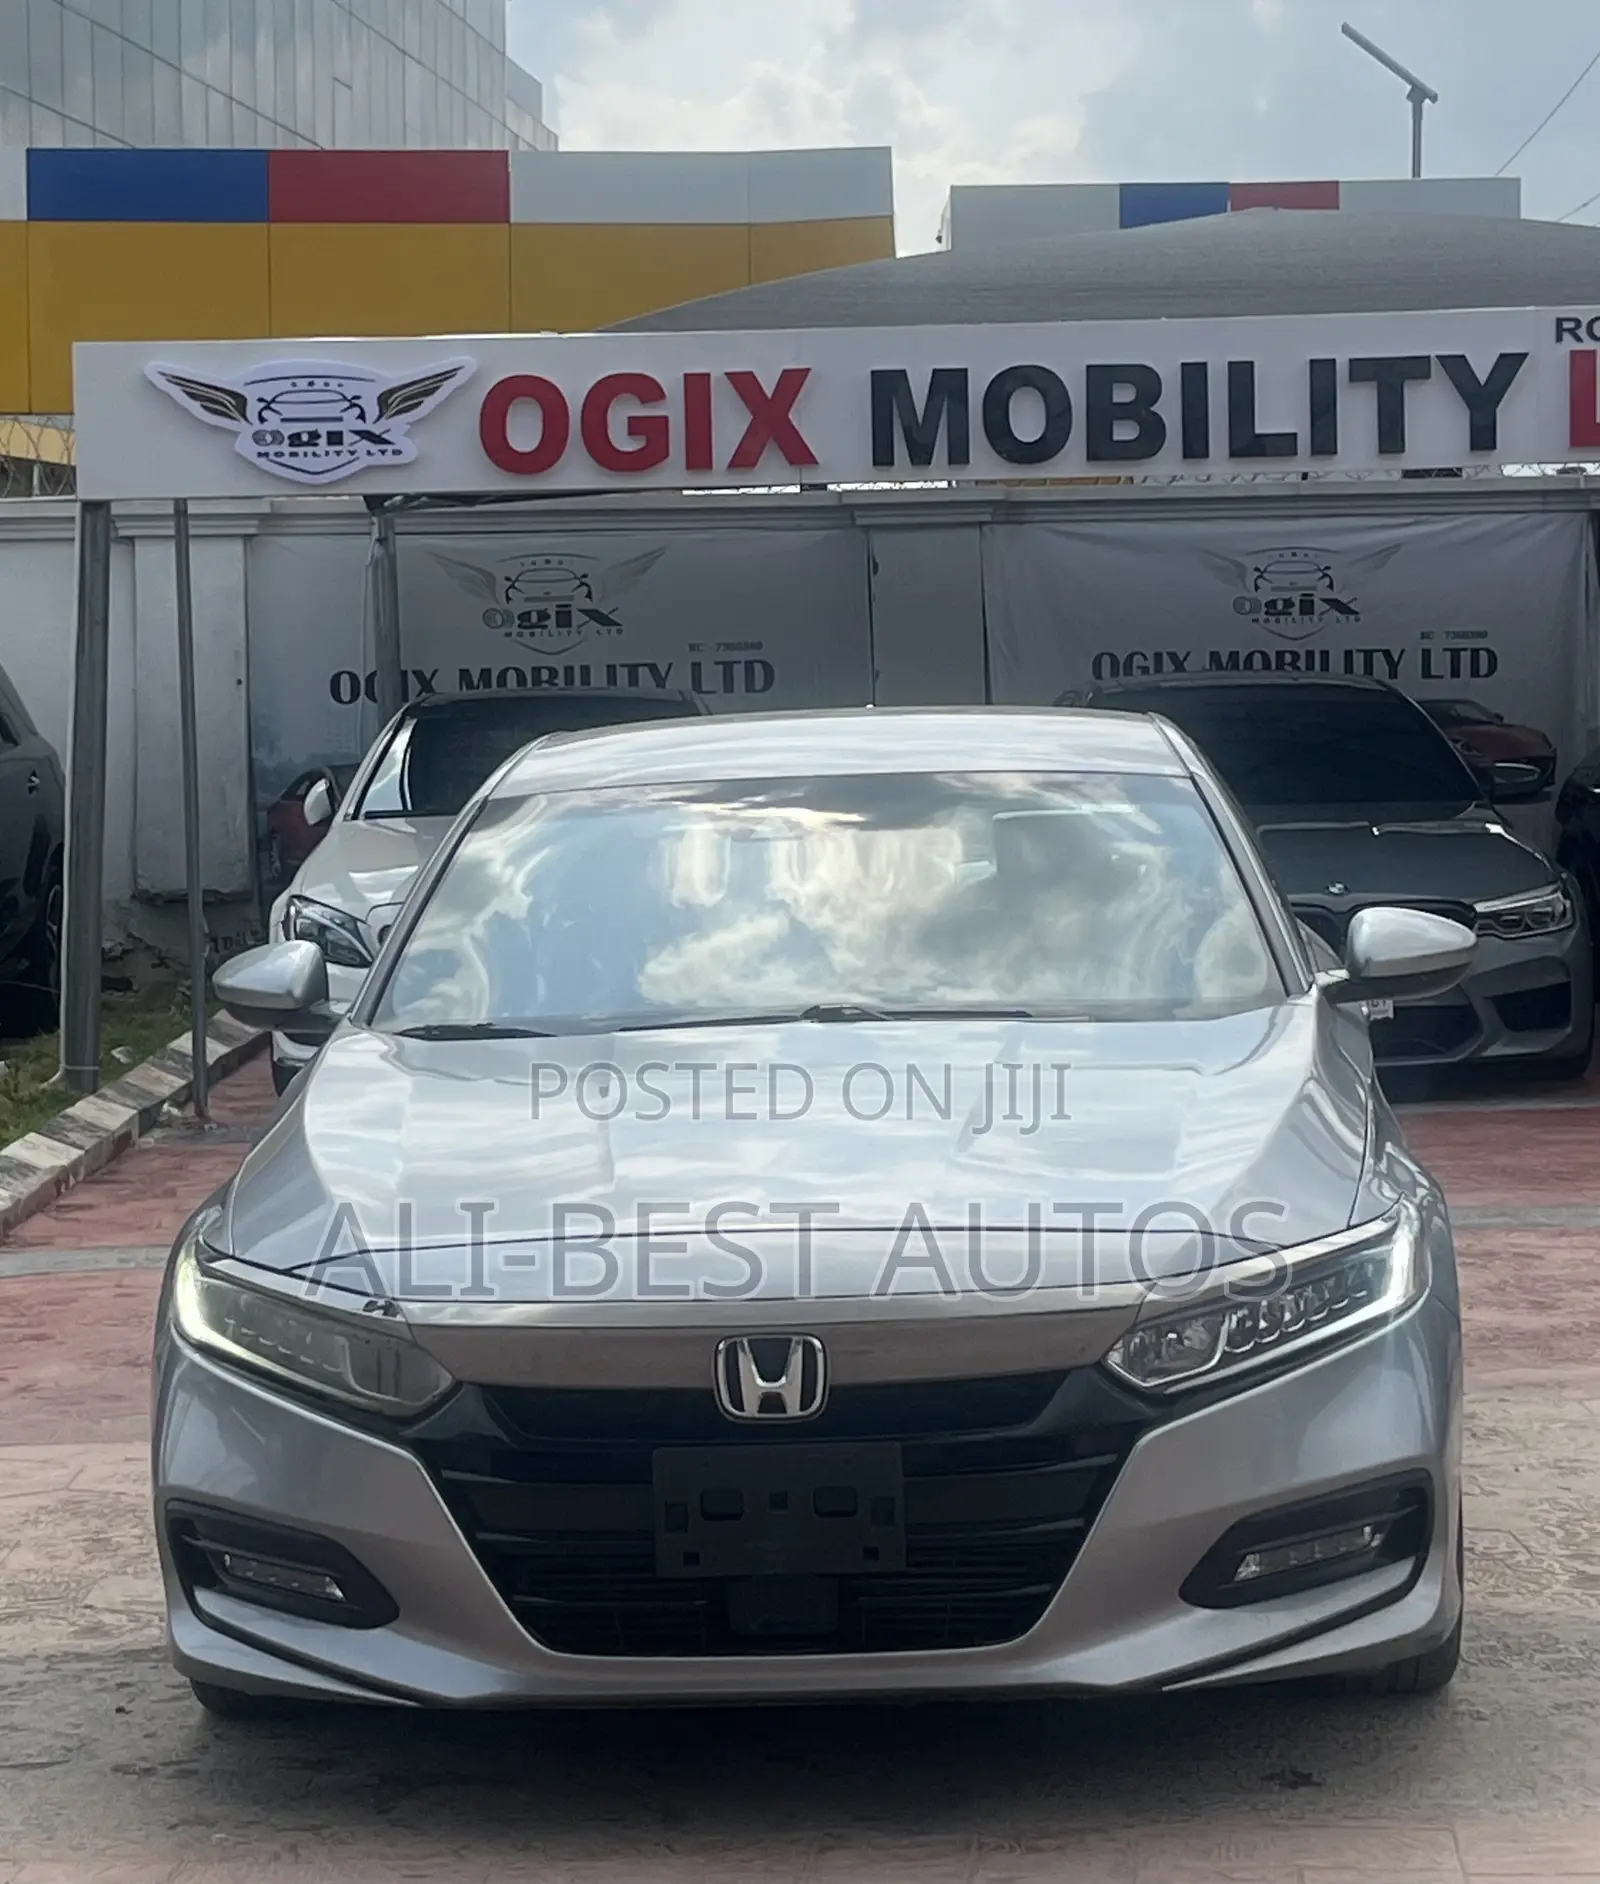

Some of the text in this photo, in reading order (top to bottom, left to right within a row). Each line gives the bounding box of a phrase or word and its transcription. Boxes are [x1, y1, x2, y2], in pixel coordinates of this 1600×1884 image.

[479, 367, 818, 475] OGIX
[870, 352, 1529, 467] MOBILITY
[256, 449, 403, 458] MOBILITY LTD
[690, 658, 775, 694] LTD
[1092, 650, 1191, 680] OGIX
[1421, 647, 1498, 679] LTD
